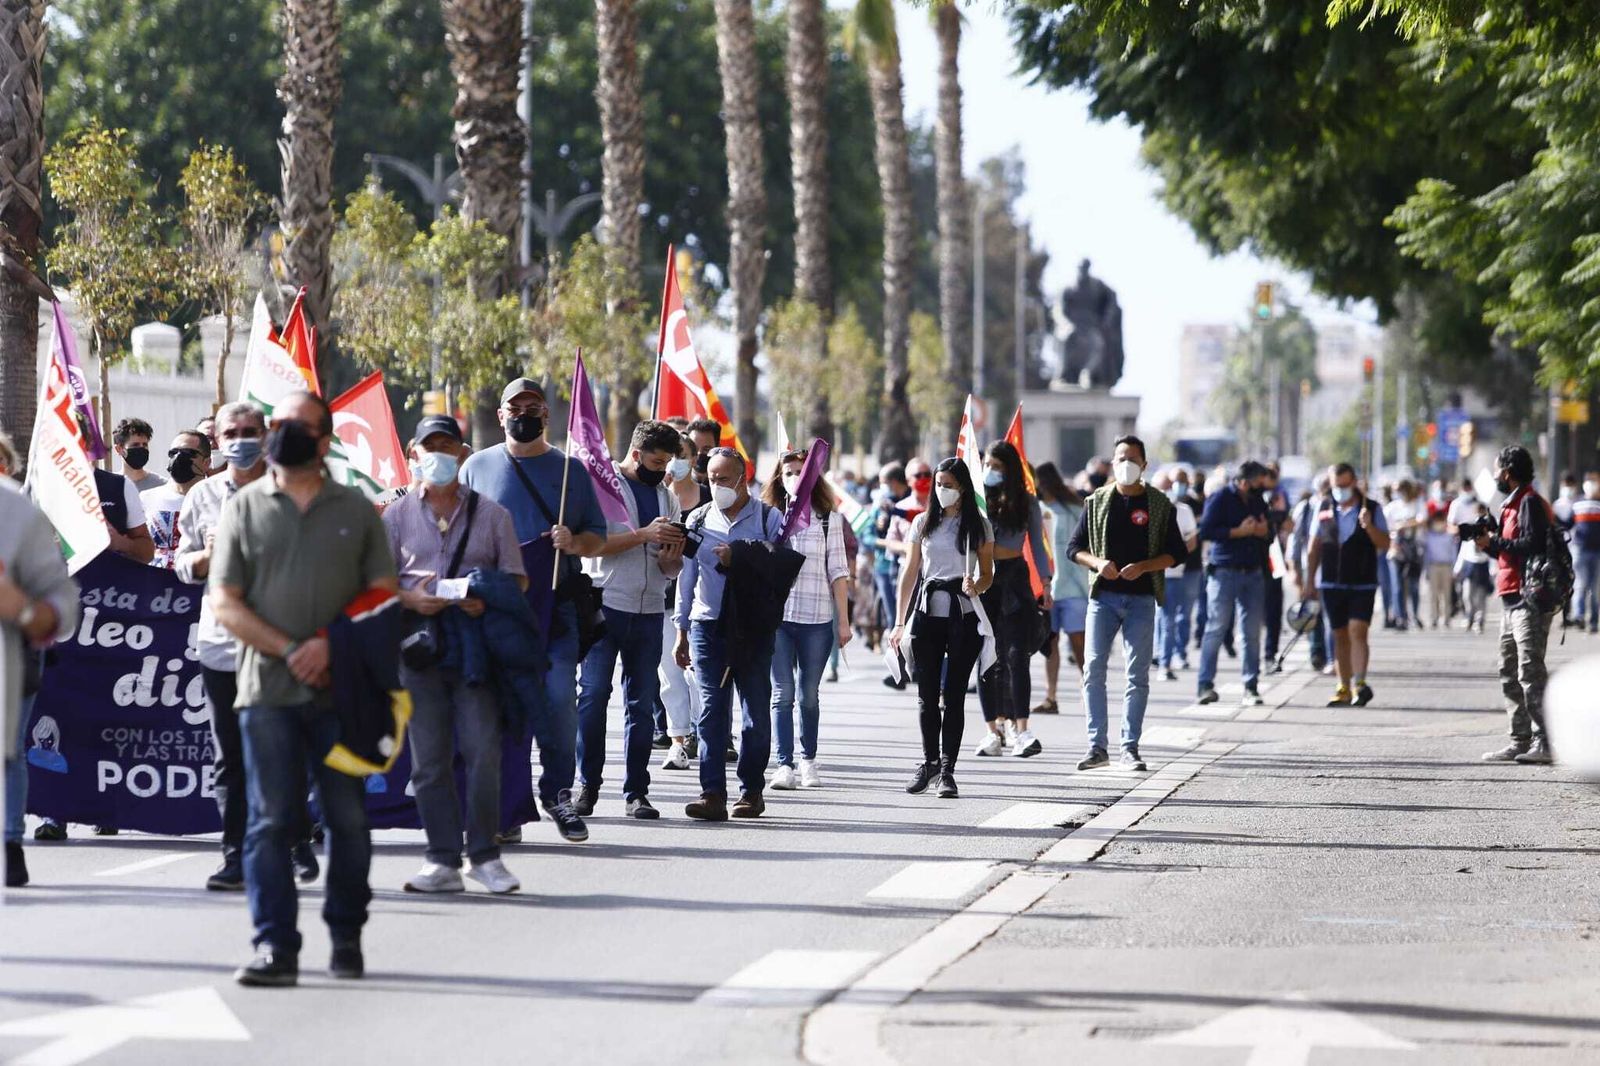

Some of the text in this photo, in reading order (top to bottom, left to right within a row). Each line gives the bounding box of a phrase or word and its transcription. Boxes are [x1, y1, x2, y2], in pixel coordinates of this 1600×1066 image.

[569, 438, 621, 494] PODEMO
[78, 586, 191, 614] sta de
[56, 607, 154, 650] leo
[100, 727, 143, 743] CON
[149, 730, 185, 745] LOS
[115, 742, 215, 761] Y LAS TRA
[97, 760, 217, 798] PODE
